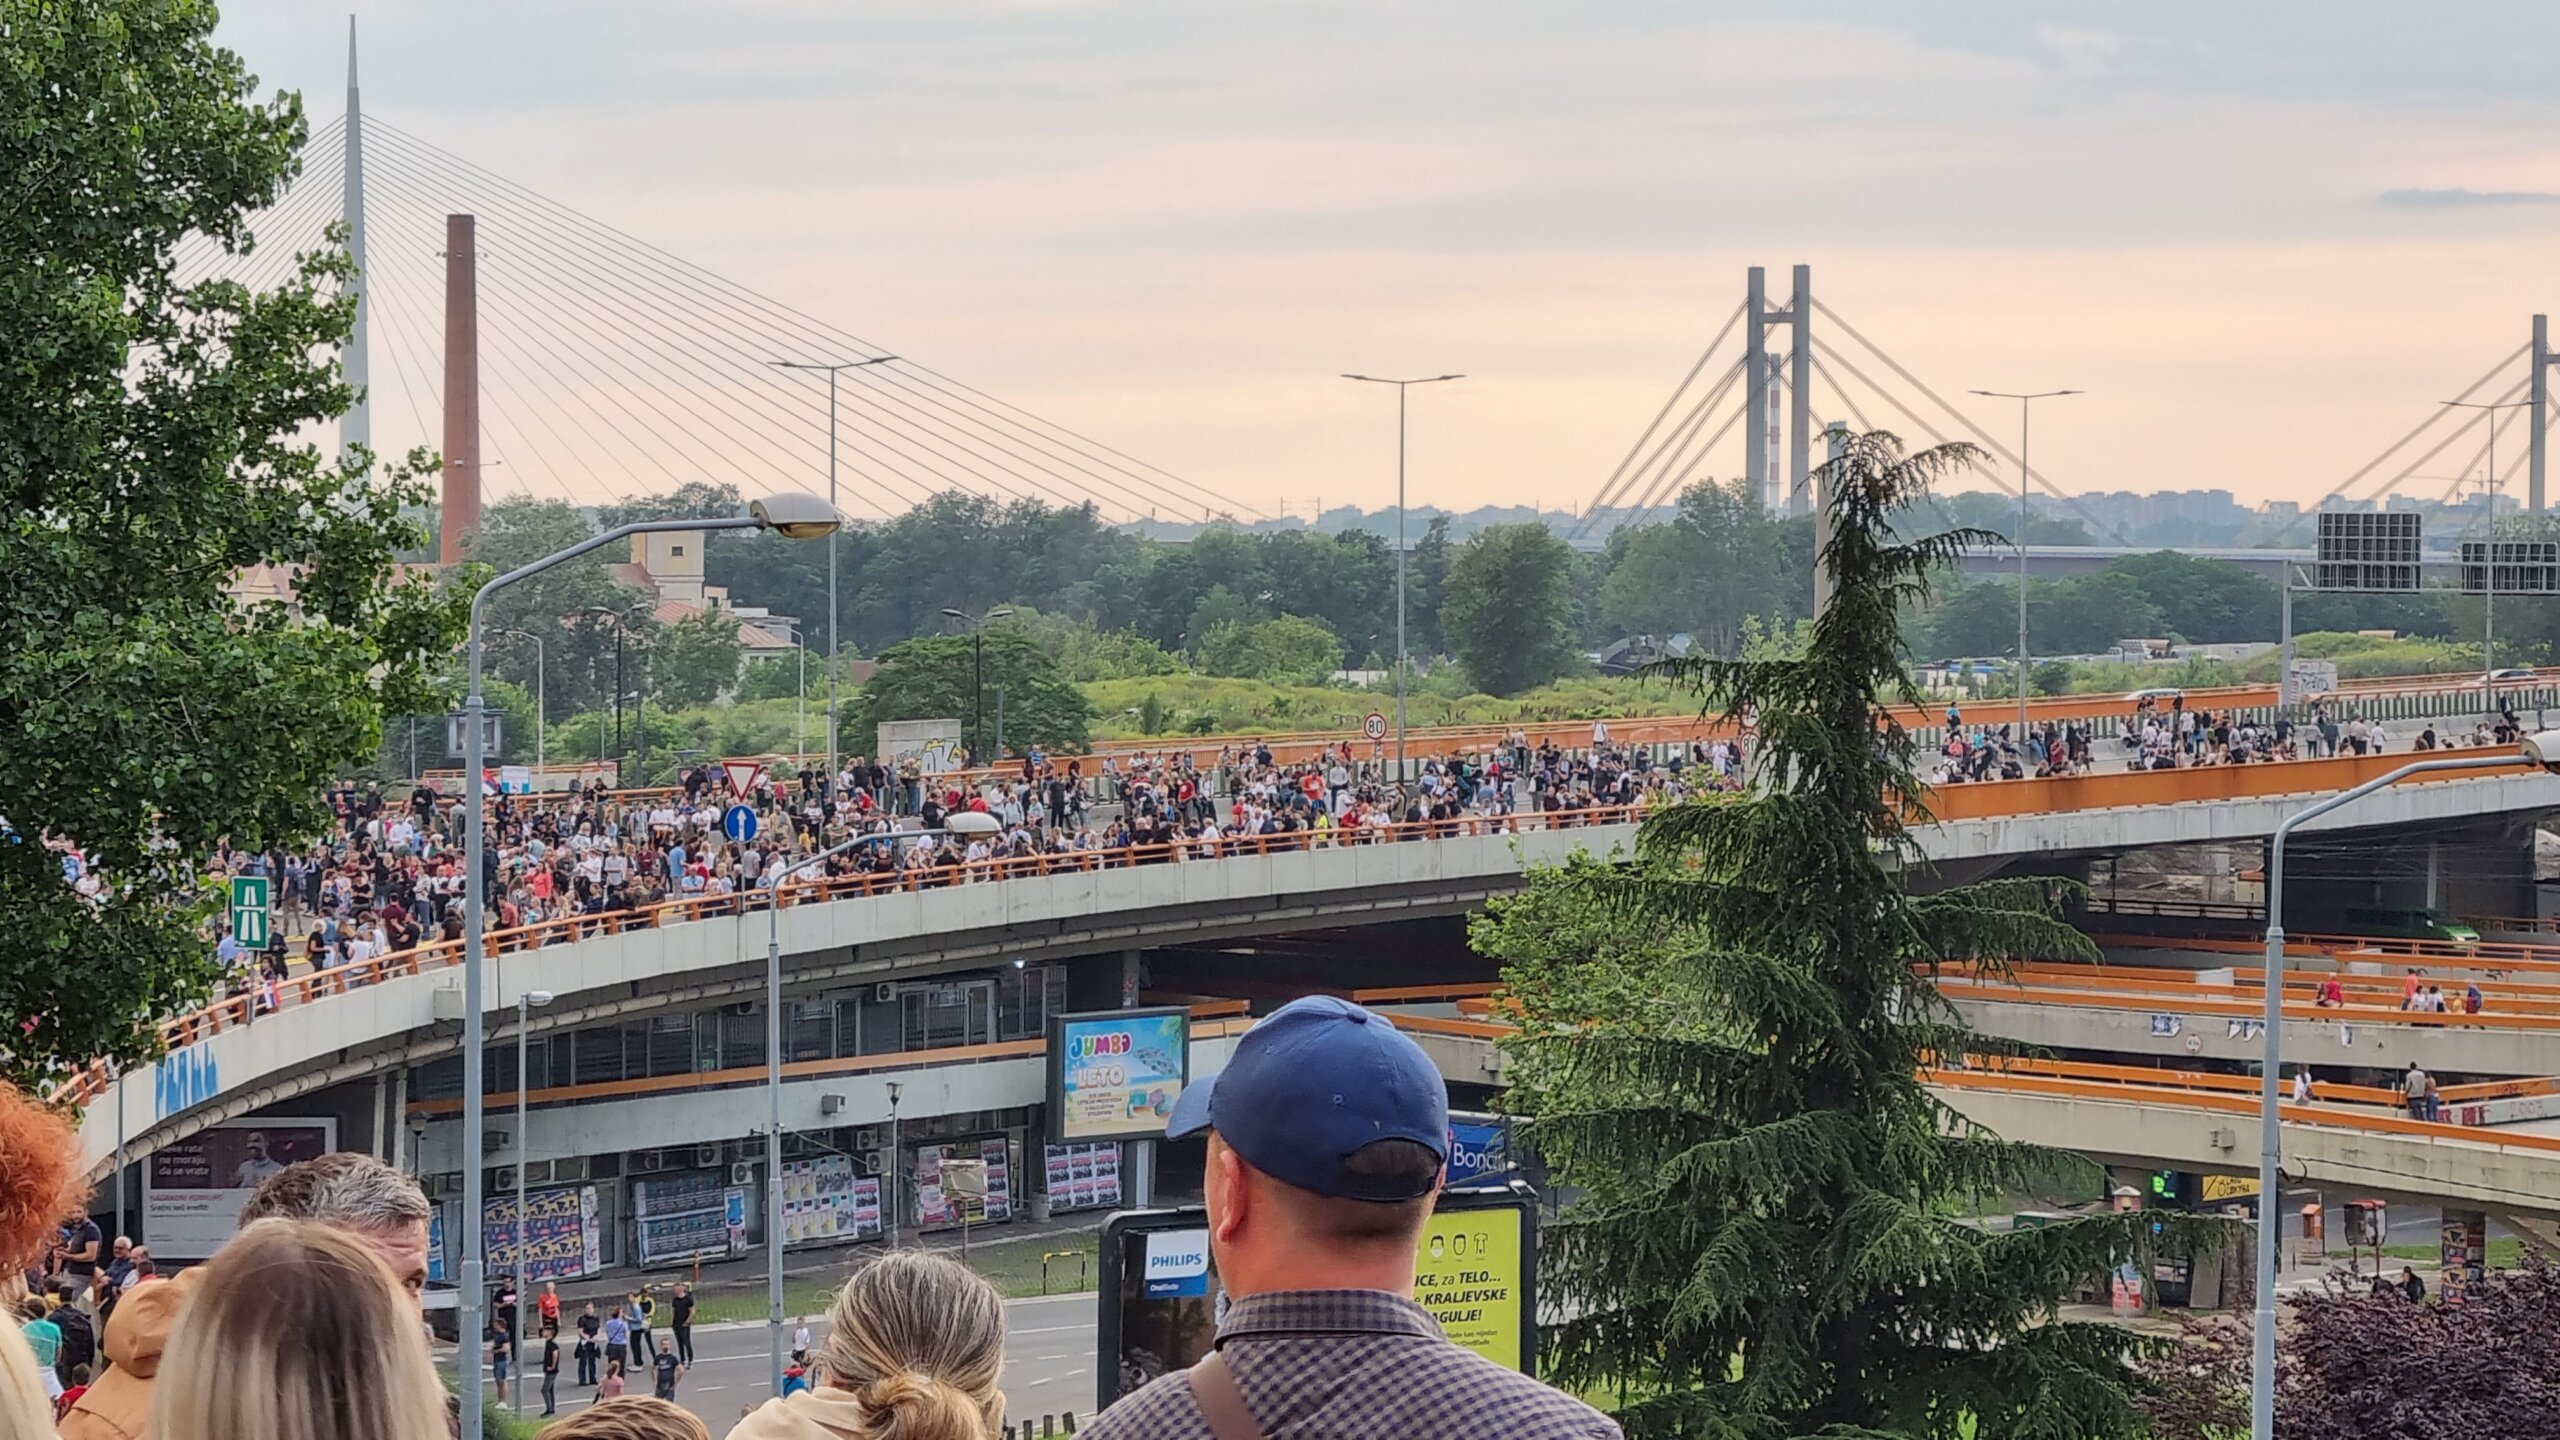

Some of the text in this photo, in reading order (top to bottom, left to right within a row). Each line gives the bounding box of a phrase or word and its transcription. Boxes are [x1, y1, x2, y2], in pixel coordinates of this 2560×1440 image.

[1368, 719, 1383, 734] 80
[1070, 1032, 1132, 1058] JUMBO
[1076, 1065, 1125, 1089] LETO
[158, 1165, 210, 1175] da se vrate
[1151, 1253, 1202, 1268] PHILIPS
[1414, 1270, 1501, 1287] ICE, za TELO...
[1424, 1288, 1508, 1306] KRALJEVSKE
